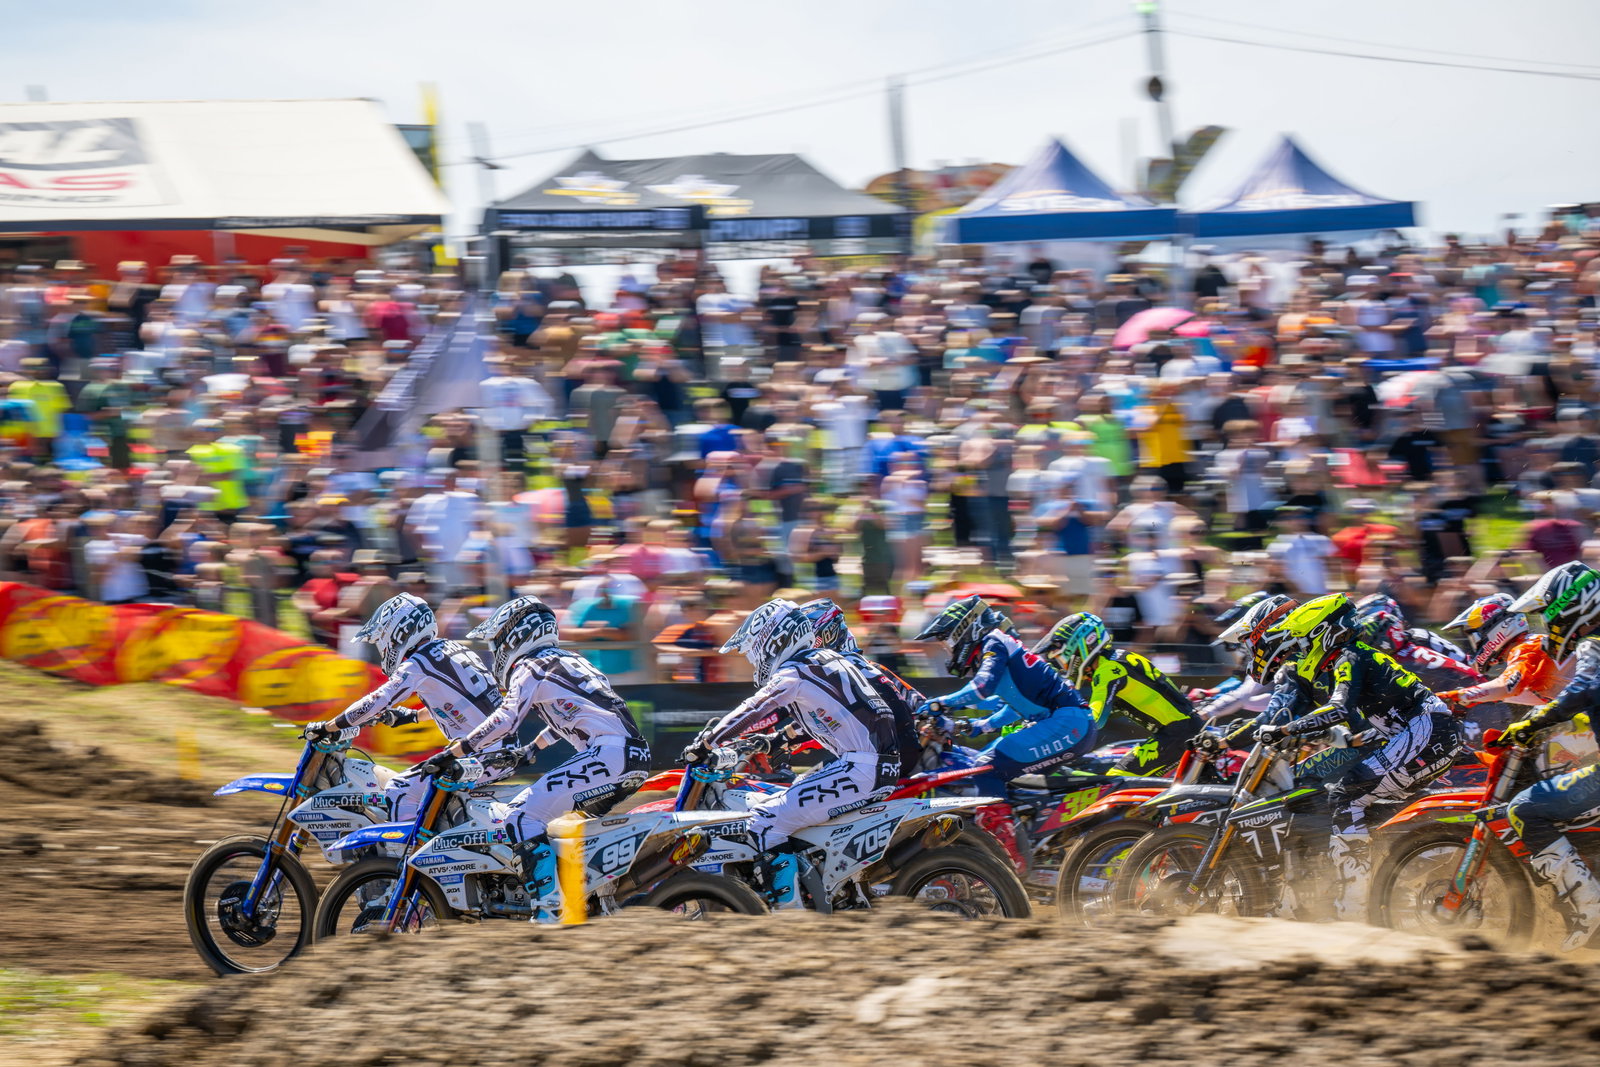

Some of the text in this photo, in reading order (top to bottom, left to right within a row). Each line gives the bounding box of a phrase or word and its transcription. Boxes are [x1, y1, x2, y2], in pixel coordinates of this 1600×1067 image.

[583, 783, 616, 798] YAMAHA
[314, 795, 362, 808] Muc-Off
[837, 799, 868, 814] YAMAHA
[1238, 811, 1282, 828] TRIUMPH
[708, 822, 743, 837] c-Off
[434, 833, 486, 850] Muc-Off
[853, 822, 893, 859] 705
[423, 855, 446, 864] YAMAHA
[602, 837, 636, 873] 99
